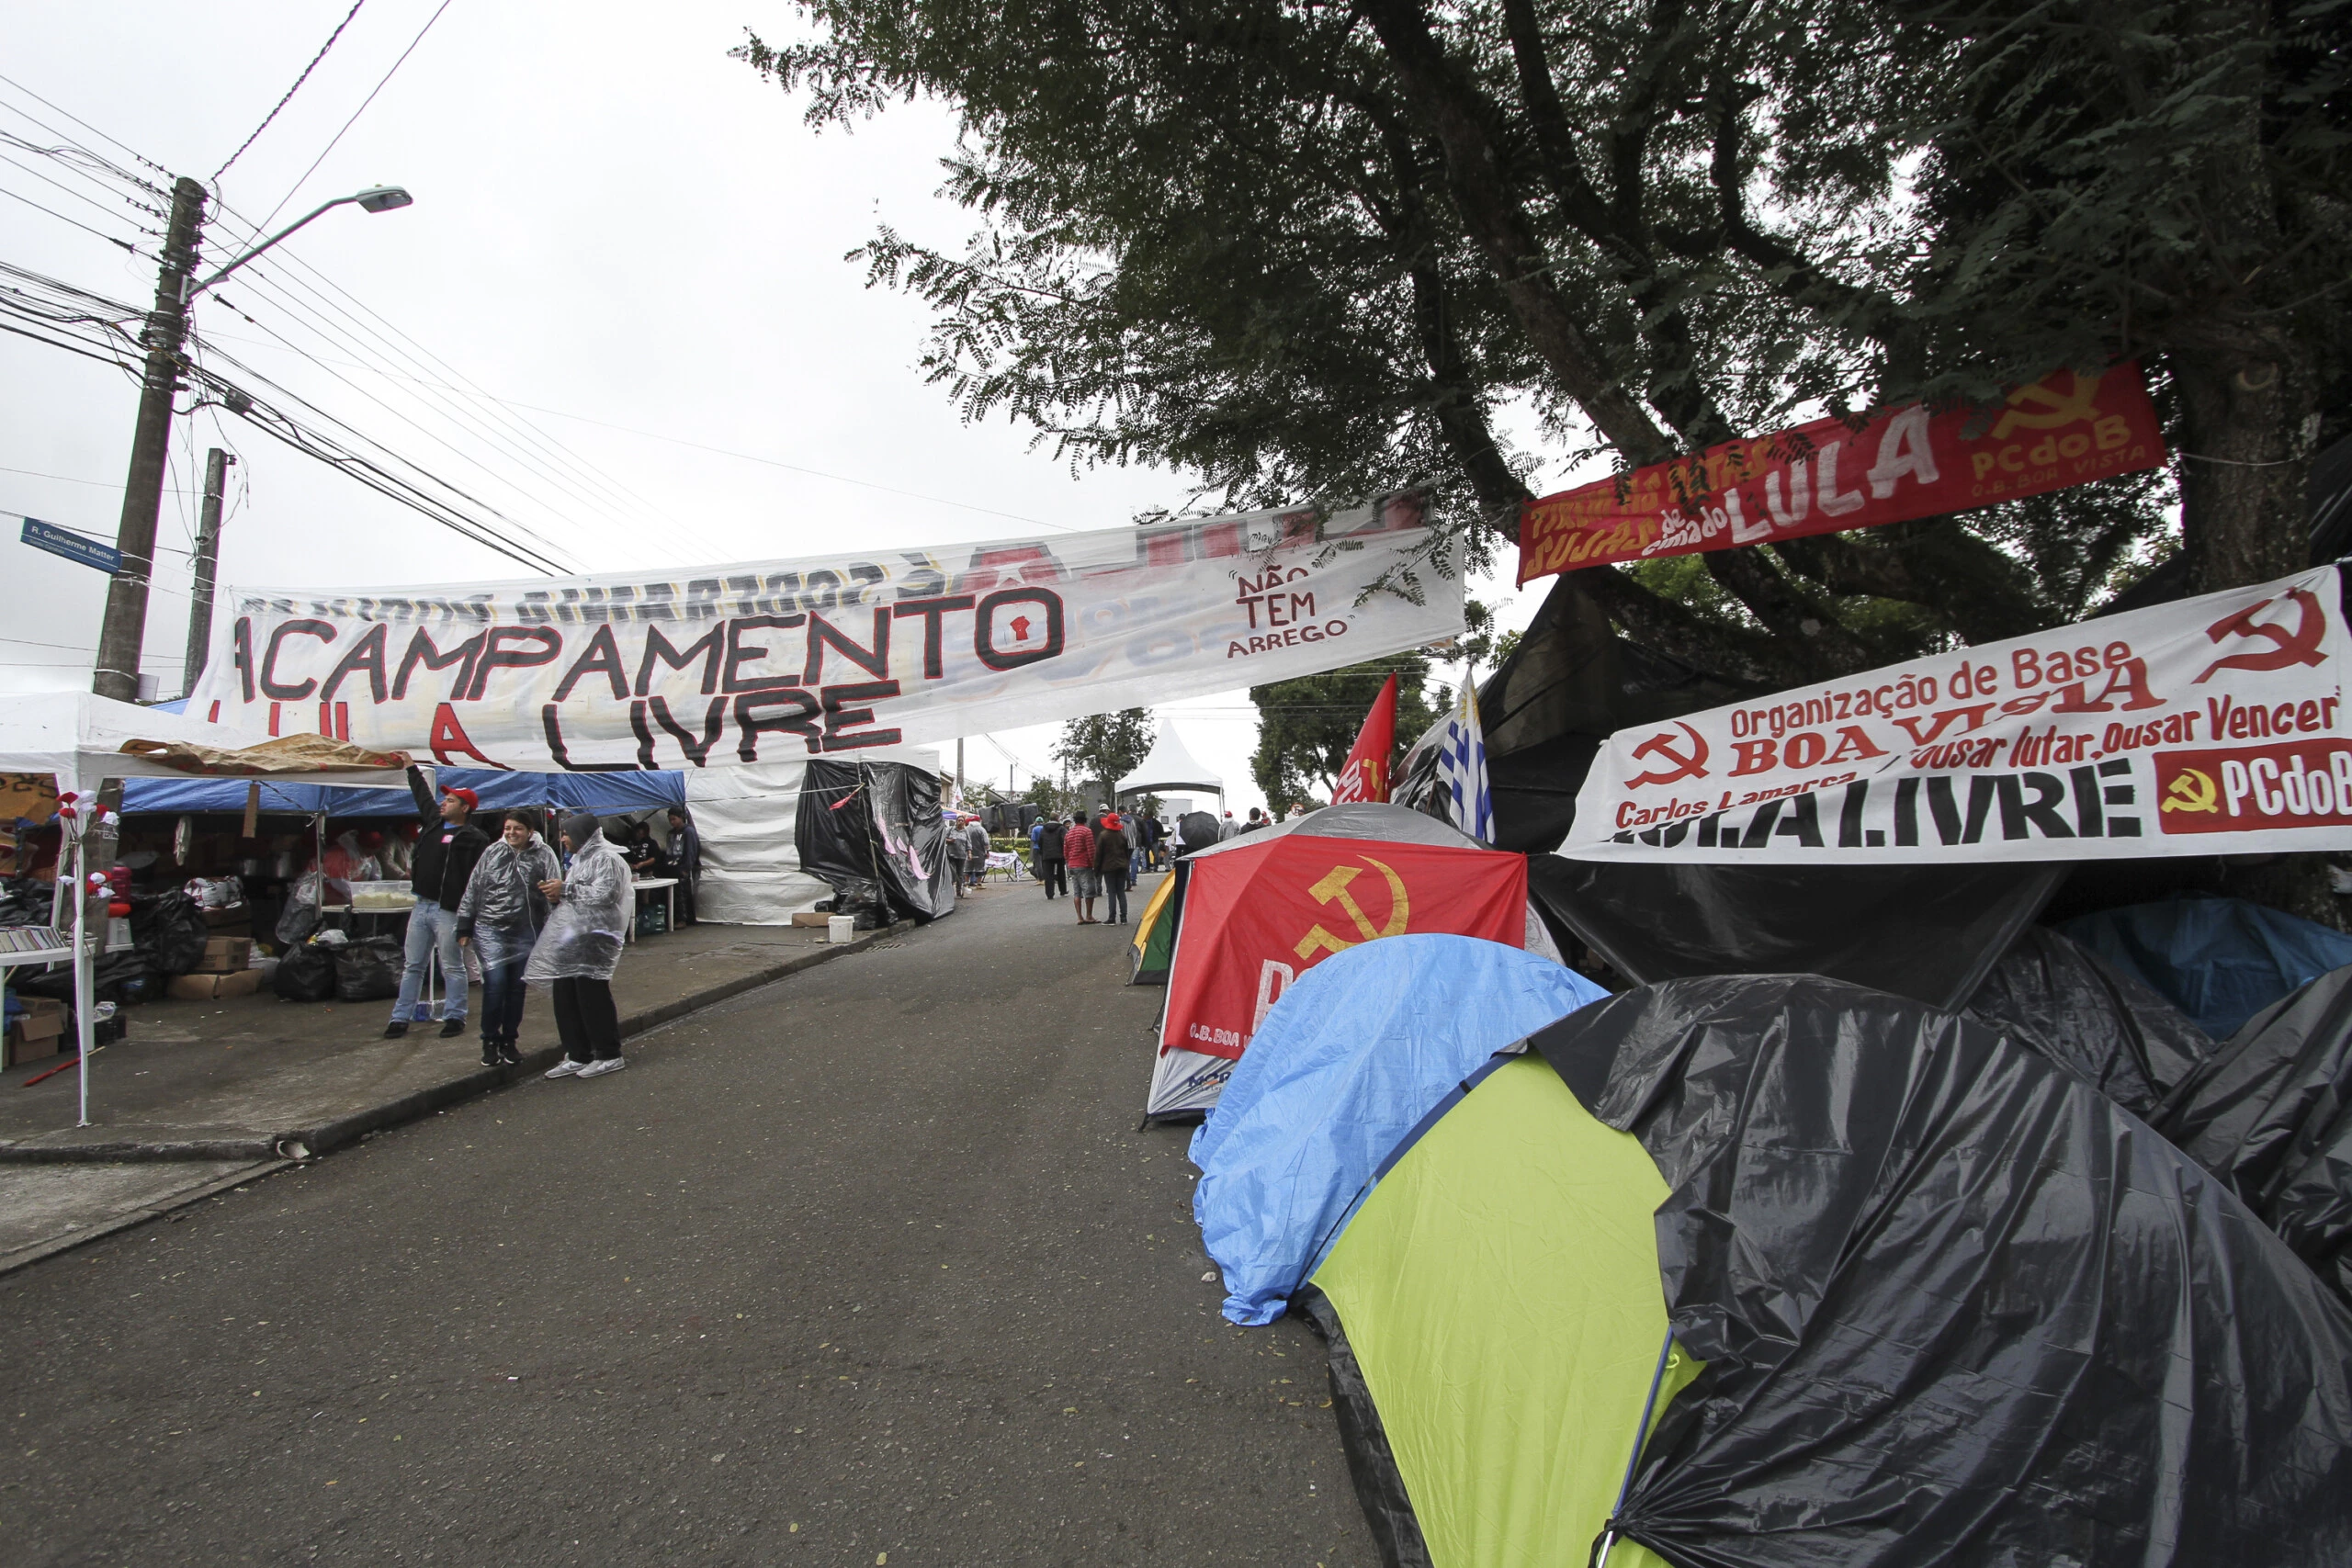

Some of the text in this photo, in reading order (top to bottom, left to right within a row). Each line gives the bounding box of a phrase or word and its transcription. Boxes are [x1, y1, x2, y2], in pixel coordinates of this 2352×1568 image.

[1724, 404, 1940, 546] LULA
[1971, 414, 2132, 480] PCdoB
[2074, 445, 2146, 474] VISTA
[31, 525, 41, 536] R.
[43, 530, 87, 551] Guilherme
[88, 546, 115, 561] Matter
[1523, 516, 1657, 580] SUJAS
[1661, 509, 1686, 535] de
[1236, 592, 1316, 629] TEM
[1731, 641, 2132, 739] Organização de Base
[541, 680, 902, 773] LIVRE
[1727, 725, 1891, 778] BOA
[1615, 772, 1858, 829] Carlos Lamarca
[1838, 758, 2143, 848] LIVRE
[2220, 750, 2352, 817] PCdoB
